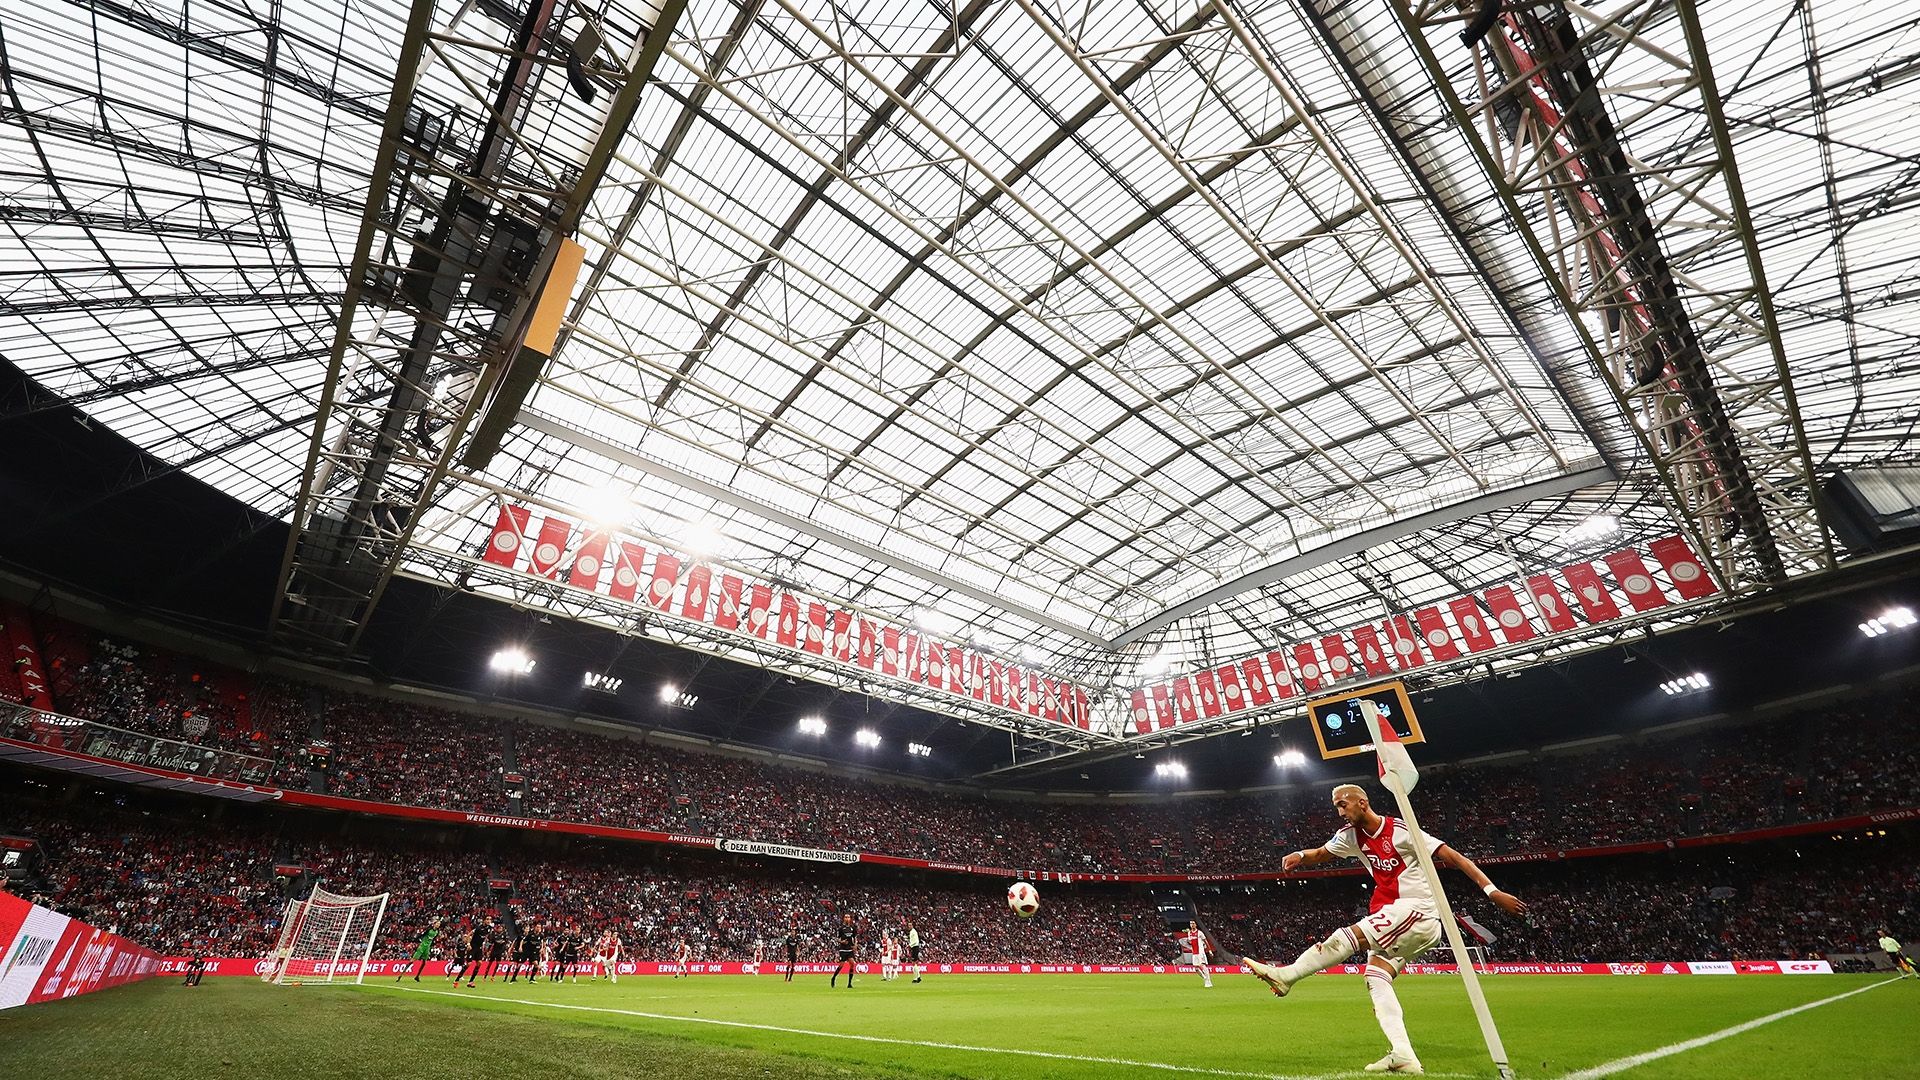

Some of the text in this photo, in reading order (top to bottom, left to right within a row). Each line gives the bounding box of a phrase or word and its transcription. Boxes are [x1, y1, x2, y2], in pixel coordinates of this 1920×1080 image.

[466, 814, 529, 826] WERELDBEKER
[668, 835, 715, 845] AMSTERDAMS
[730, 843, 858, 862] DEZE MAN VERDIENT EEN STANDBEELD
[1368, 913, 1392, 933] 22
[314, 963, 357, 973] ERAAR
[364, 963, 387, 973] HET
[658, 964, 688, 973] ERVA
[1494, 965, 1584, 974] FOXSPORTS.NL/AJAX
